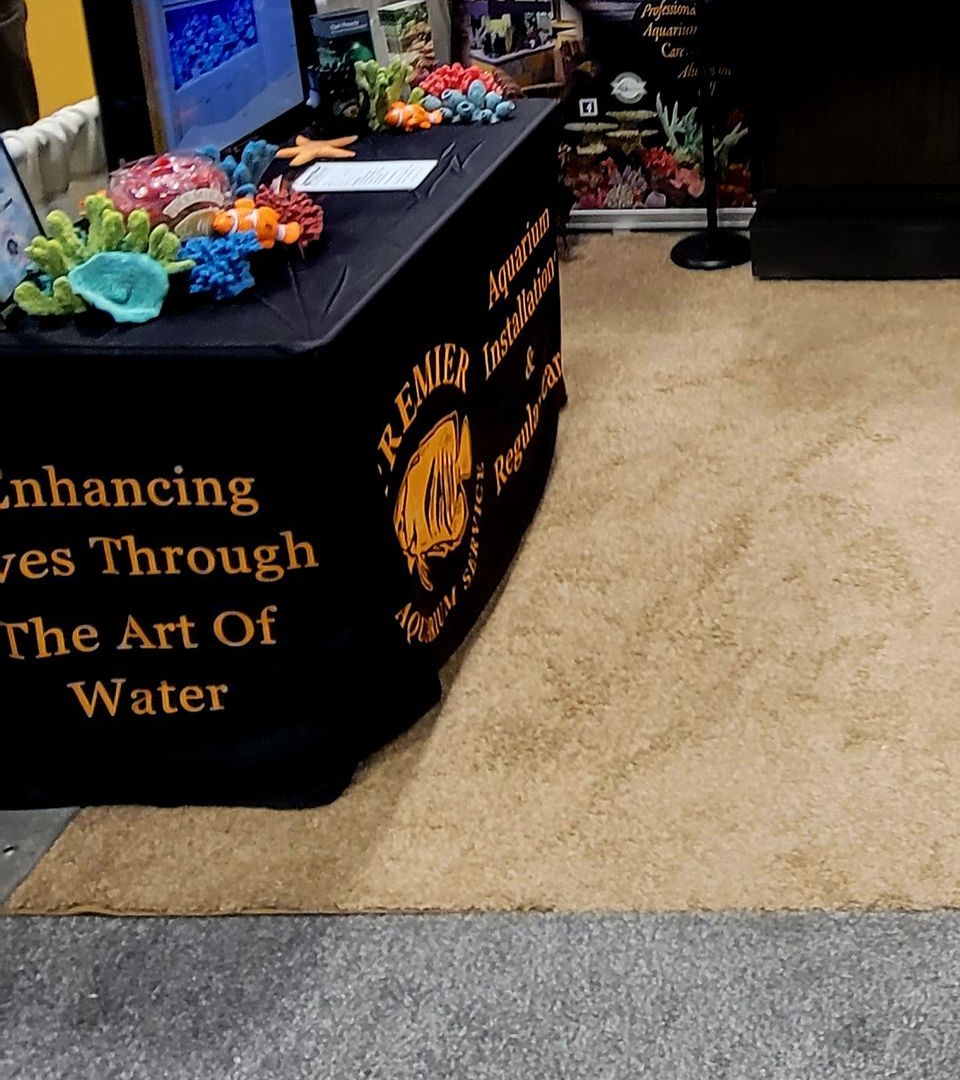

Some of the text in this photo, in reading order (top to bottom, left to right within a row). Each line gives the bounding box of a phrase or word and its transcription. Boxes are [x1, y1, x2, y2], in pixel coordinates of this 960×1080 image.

[640, 0, 697, 21] Professiona
[488, 207, 550, 311] Aquarium
[482, 249, 557, 381] Installation
[525, 344, 535, 380] &
[376, 342, 469, 498] REMIER
[88, 530, 319, 583] Through
[0, 605, 278, 660] The Art Of
[67, 678, 229, 718] Water
